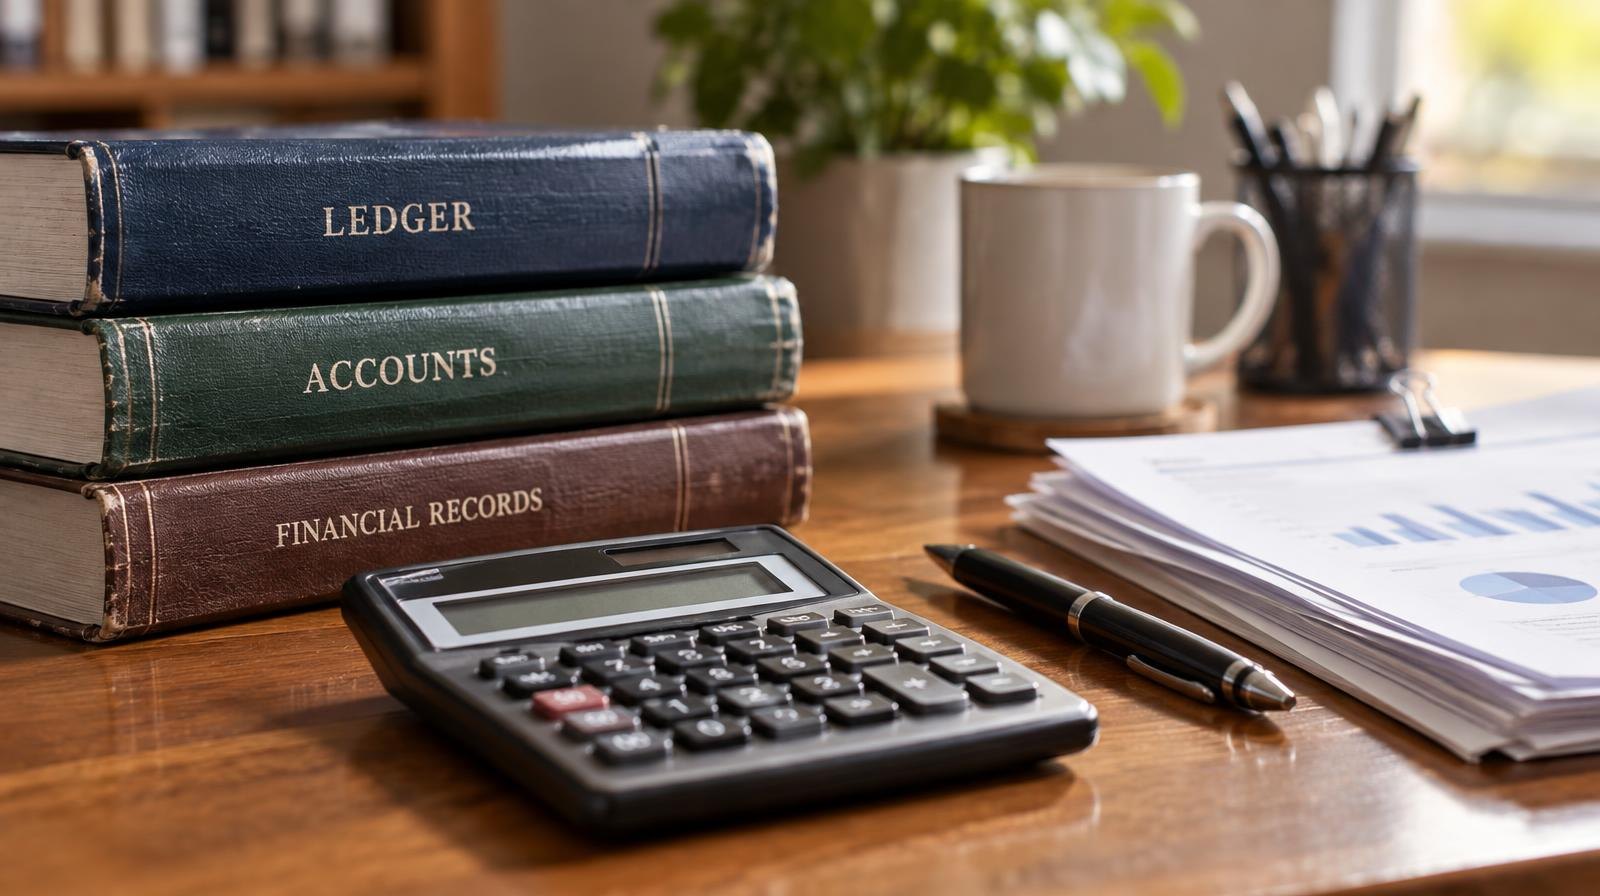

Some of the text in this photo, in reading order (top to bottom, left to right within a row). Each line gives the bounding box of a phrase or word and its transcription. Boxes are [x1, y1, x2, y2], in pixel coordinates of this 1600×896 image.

[323, 201, 475, 237] LEDGER
[303, 347, 497, 393] ACCOUNTS
[275, 488, 543, 548] FINANCIAL RECORDS
